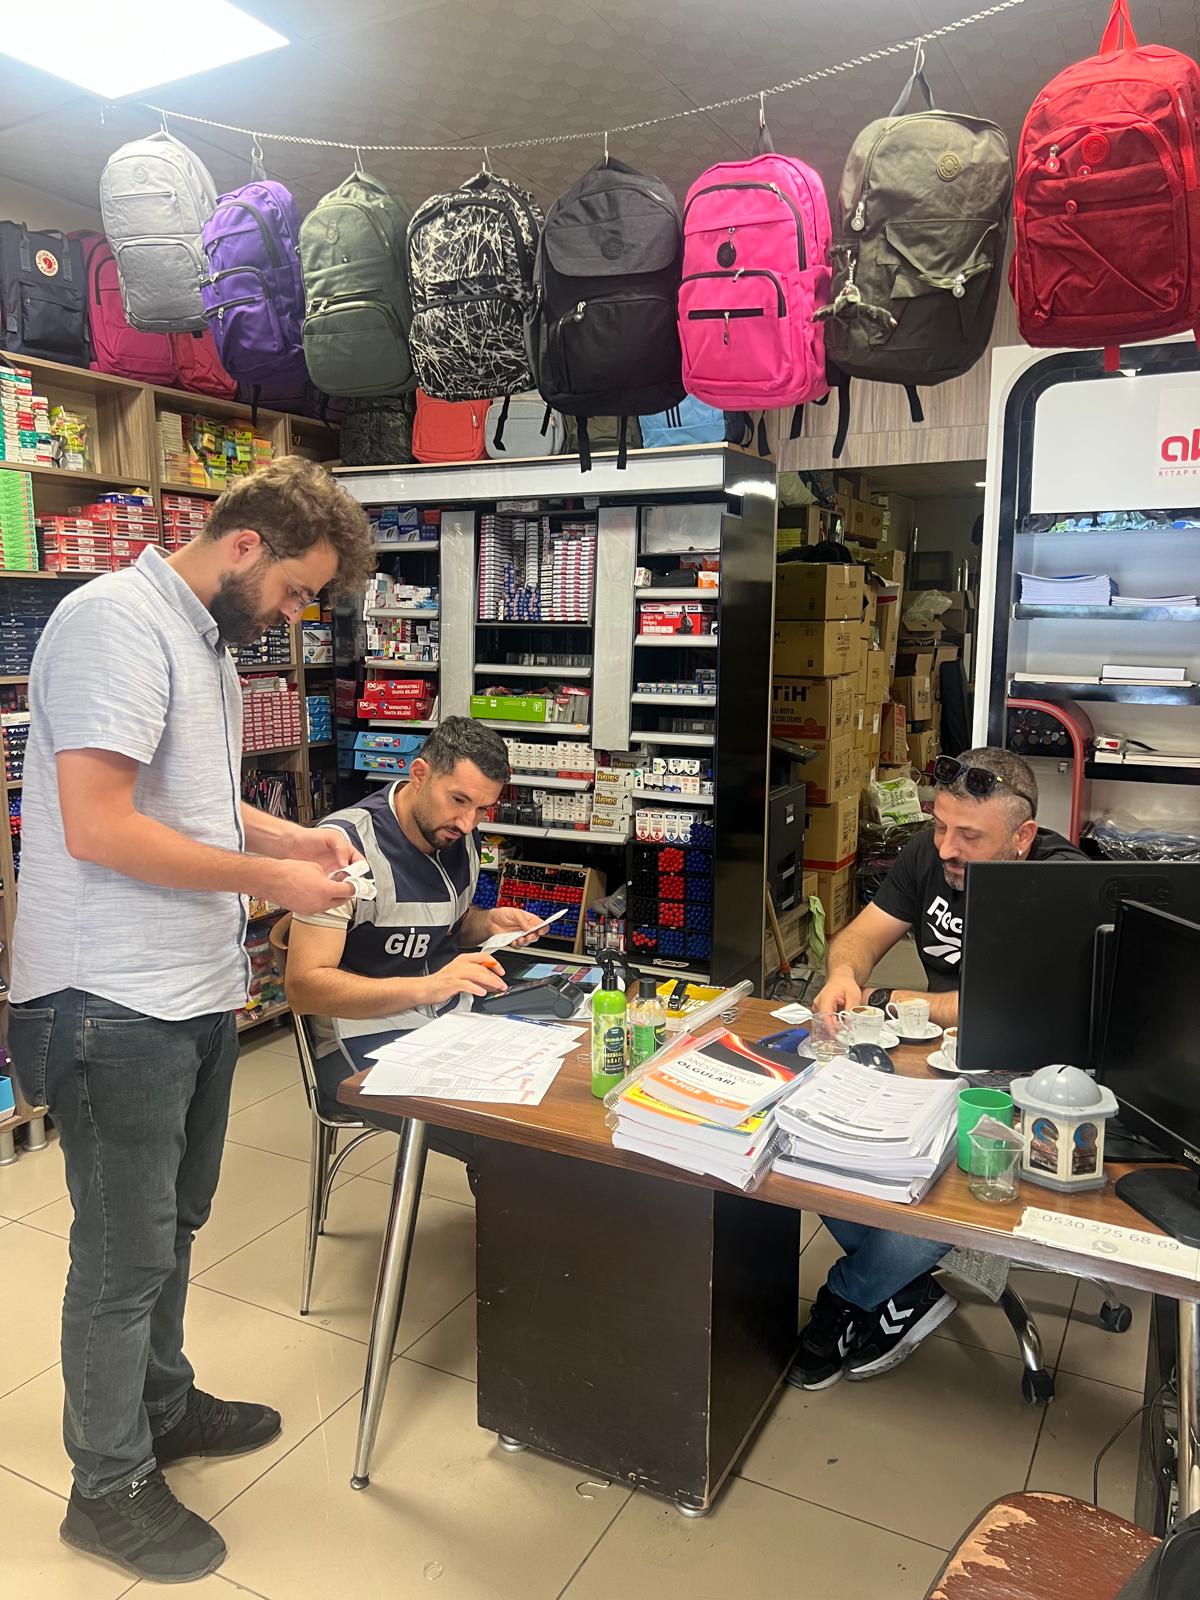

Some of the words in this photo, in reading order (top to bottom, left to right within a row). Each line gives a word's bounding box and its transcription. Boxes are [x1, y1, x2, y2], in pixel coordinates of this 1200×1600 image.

[384, 927, 431, 958] GİB
[661, 1074, 705, 1095] LANGE
[1042, 1214, 1085, 1230] 0530
[1129, 1234, 1152, 1245] 68
[1157, 1240, 1180, 1251] 69
